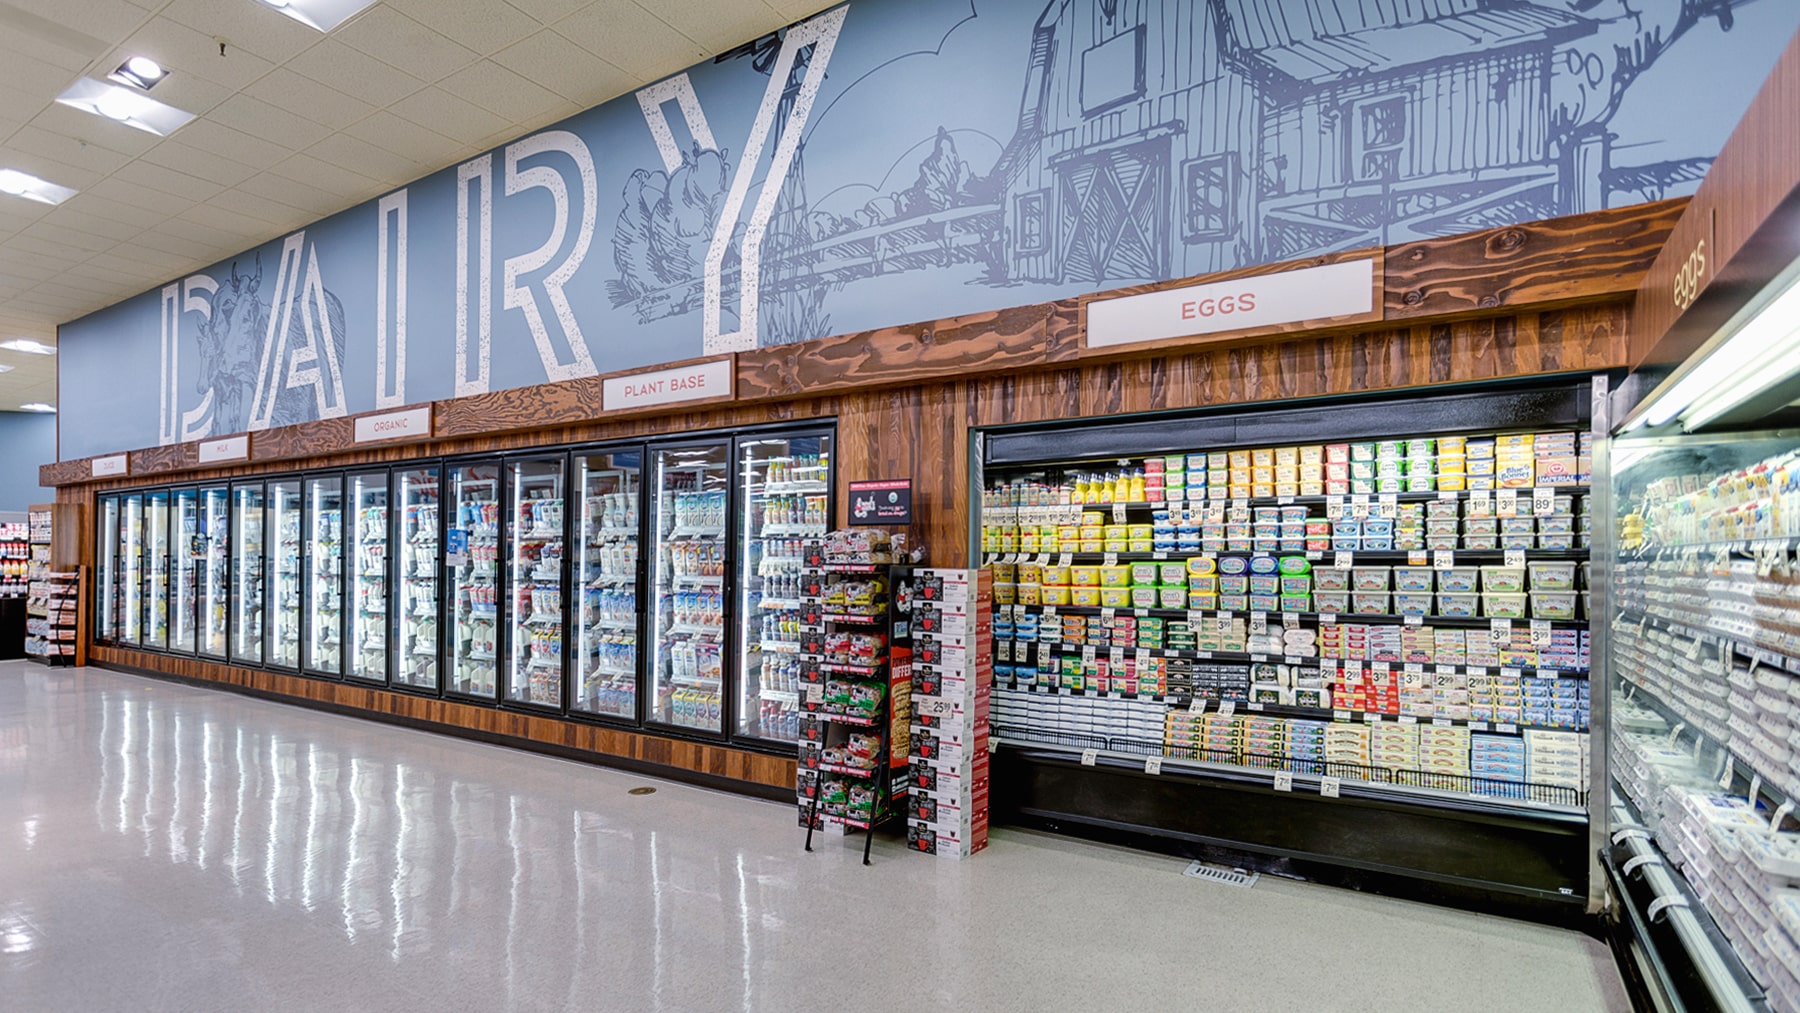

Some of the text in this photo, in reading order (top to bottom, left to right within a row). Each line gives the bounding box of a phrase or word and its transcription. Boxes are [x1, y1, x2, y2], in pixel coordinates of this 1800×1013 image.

[159, 4, 850, 446] DAIRY
[1674, 238, 1705, 310] eggs
[1182, 293, 1256, 320] EGGS
[624, 375, 705, 398] PLANT BASE
[374, 418, 408, 432] ORGANIC
[216, 444, 228, 453] MILK
[1501, 470, 1530, 479] Bonnet
[1505, 466, 1525, 474] Blue
